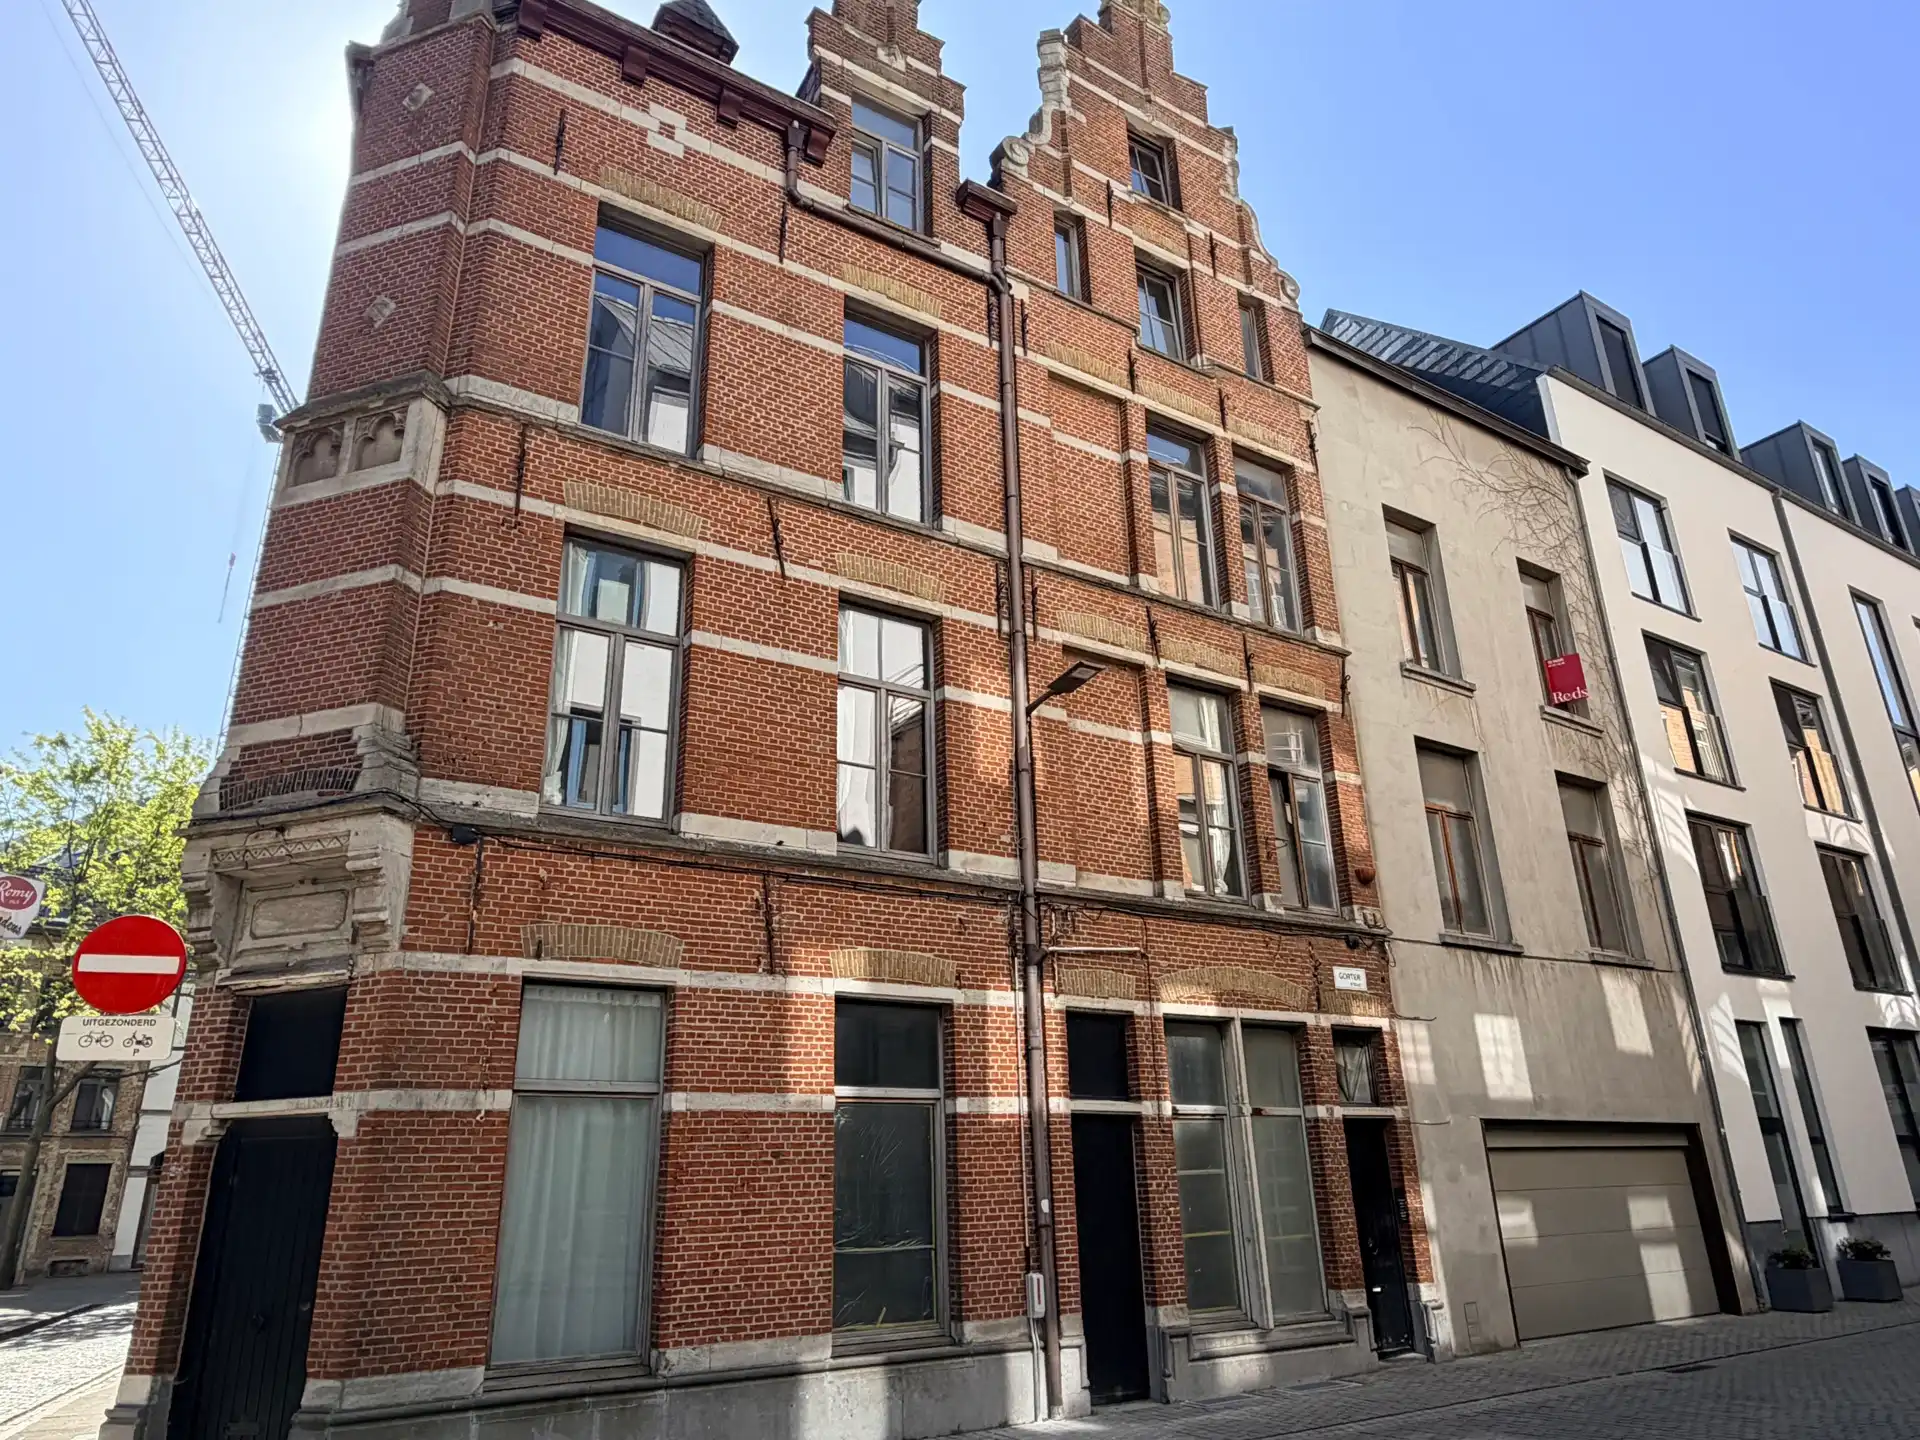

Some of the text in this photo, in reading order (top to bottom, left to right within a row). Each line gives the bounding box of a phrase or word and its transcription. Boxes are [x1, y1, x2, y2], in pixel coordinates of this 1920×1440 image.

[1552, 686, 1592, 704] Reds
[0, 880, 34, 905] Romy
[82, 1018, 156, 1027] UITGEZONDERD
[132, 1048, 140, 1056] P
